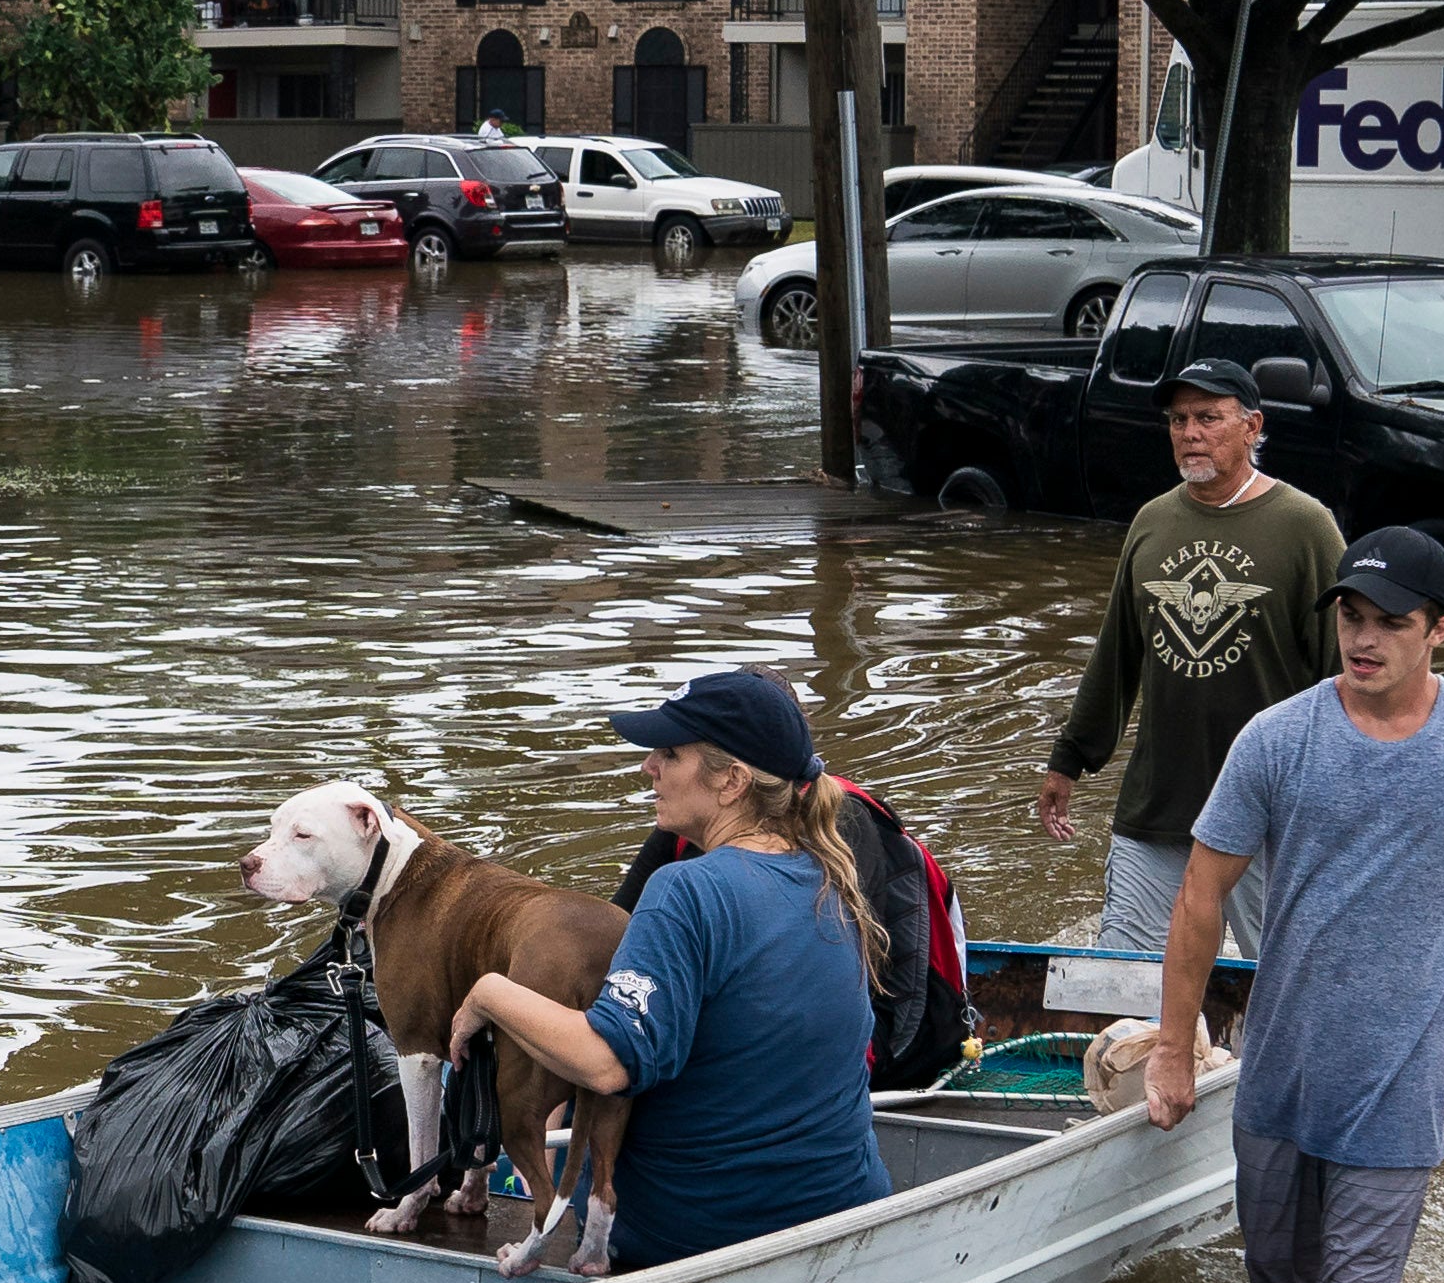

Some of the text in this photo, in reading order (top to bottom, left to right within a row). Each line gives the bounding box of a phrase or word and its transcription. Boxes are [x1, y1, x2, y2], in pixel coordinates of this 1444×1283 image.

[1352, 558, 1387, 569] adidas
[1152, 628, 1253, 678] DAVIDSON
[614, 975, 643, 988] TEXAS
